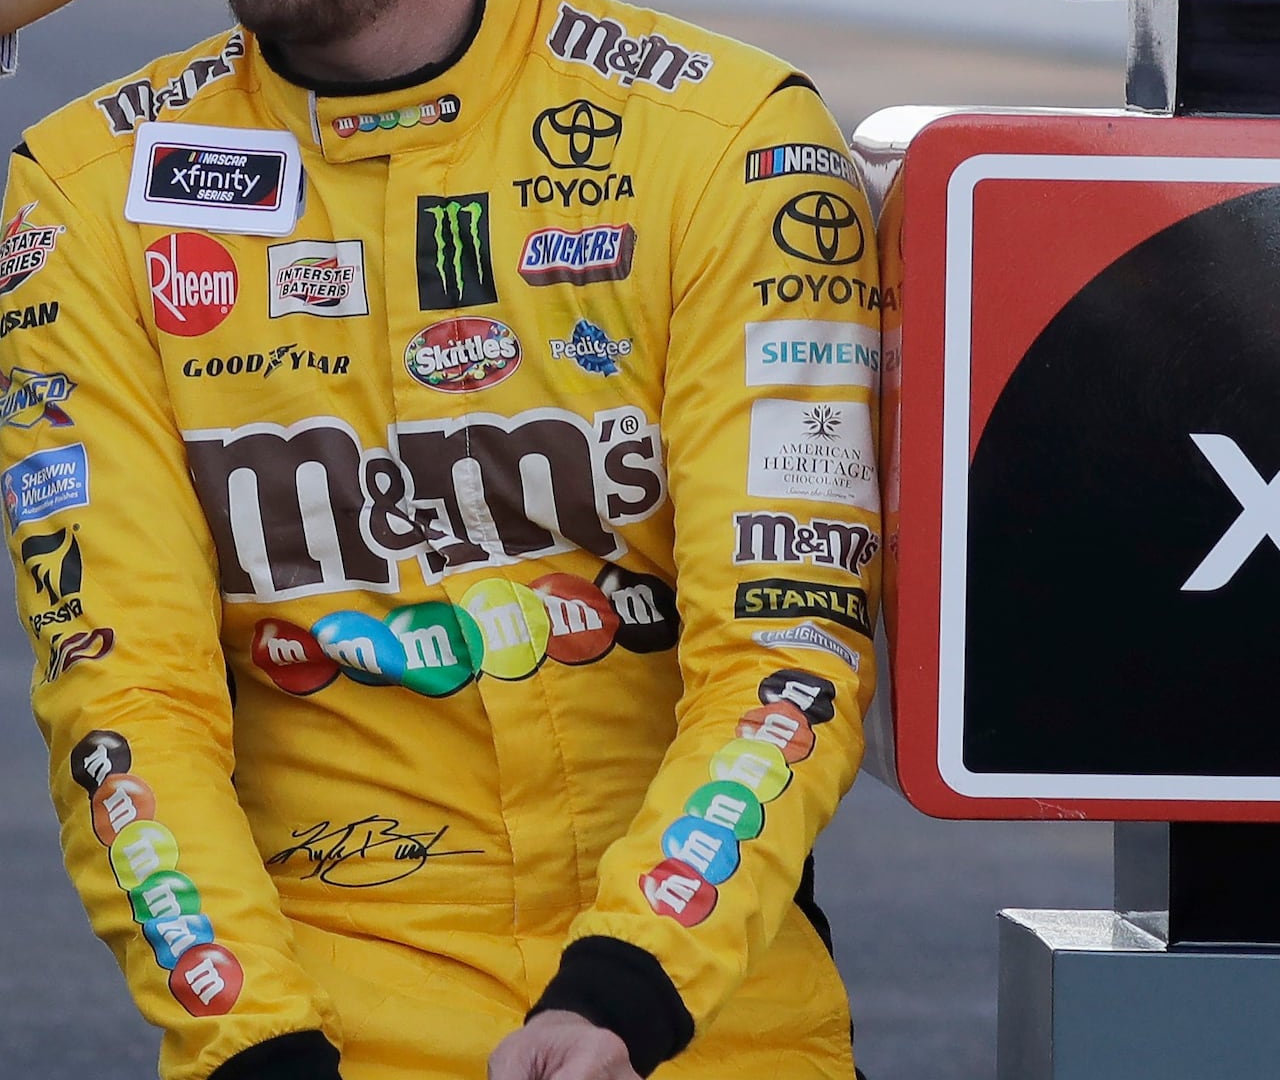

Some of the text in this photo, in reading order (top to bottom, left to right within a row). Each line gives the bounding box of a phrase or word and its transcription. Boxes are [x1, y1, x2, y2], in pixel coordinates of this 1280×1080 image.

[202, 153, 247, 167] NASCAR
[171, 165, 260, 197] xfinity
[197, 190, 234, 201] SERIES
[513, 174, 634, 207] TOYOTA
[526, 230, 619, 266] SNICKERS
[145, 233, 235, 321] Rheem
[753, 274, 882, 311] TOYOTA
[415, 335, 516, 376] Skittles
[761, 341, 879, 371] SIEMENS
[779, 443, 862, 460] AMERICAN
[22, 462, 76, 491] SHERWIN
[763, 455, 872, 482] HERITAGE
[784, 473, 853, 489] CHOCOLATE
[22, 477, 76, 508] WILLIAMS
